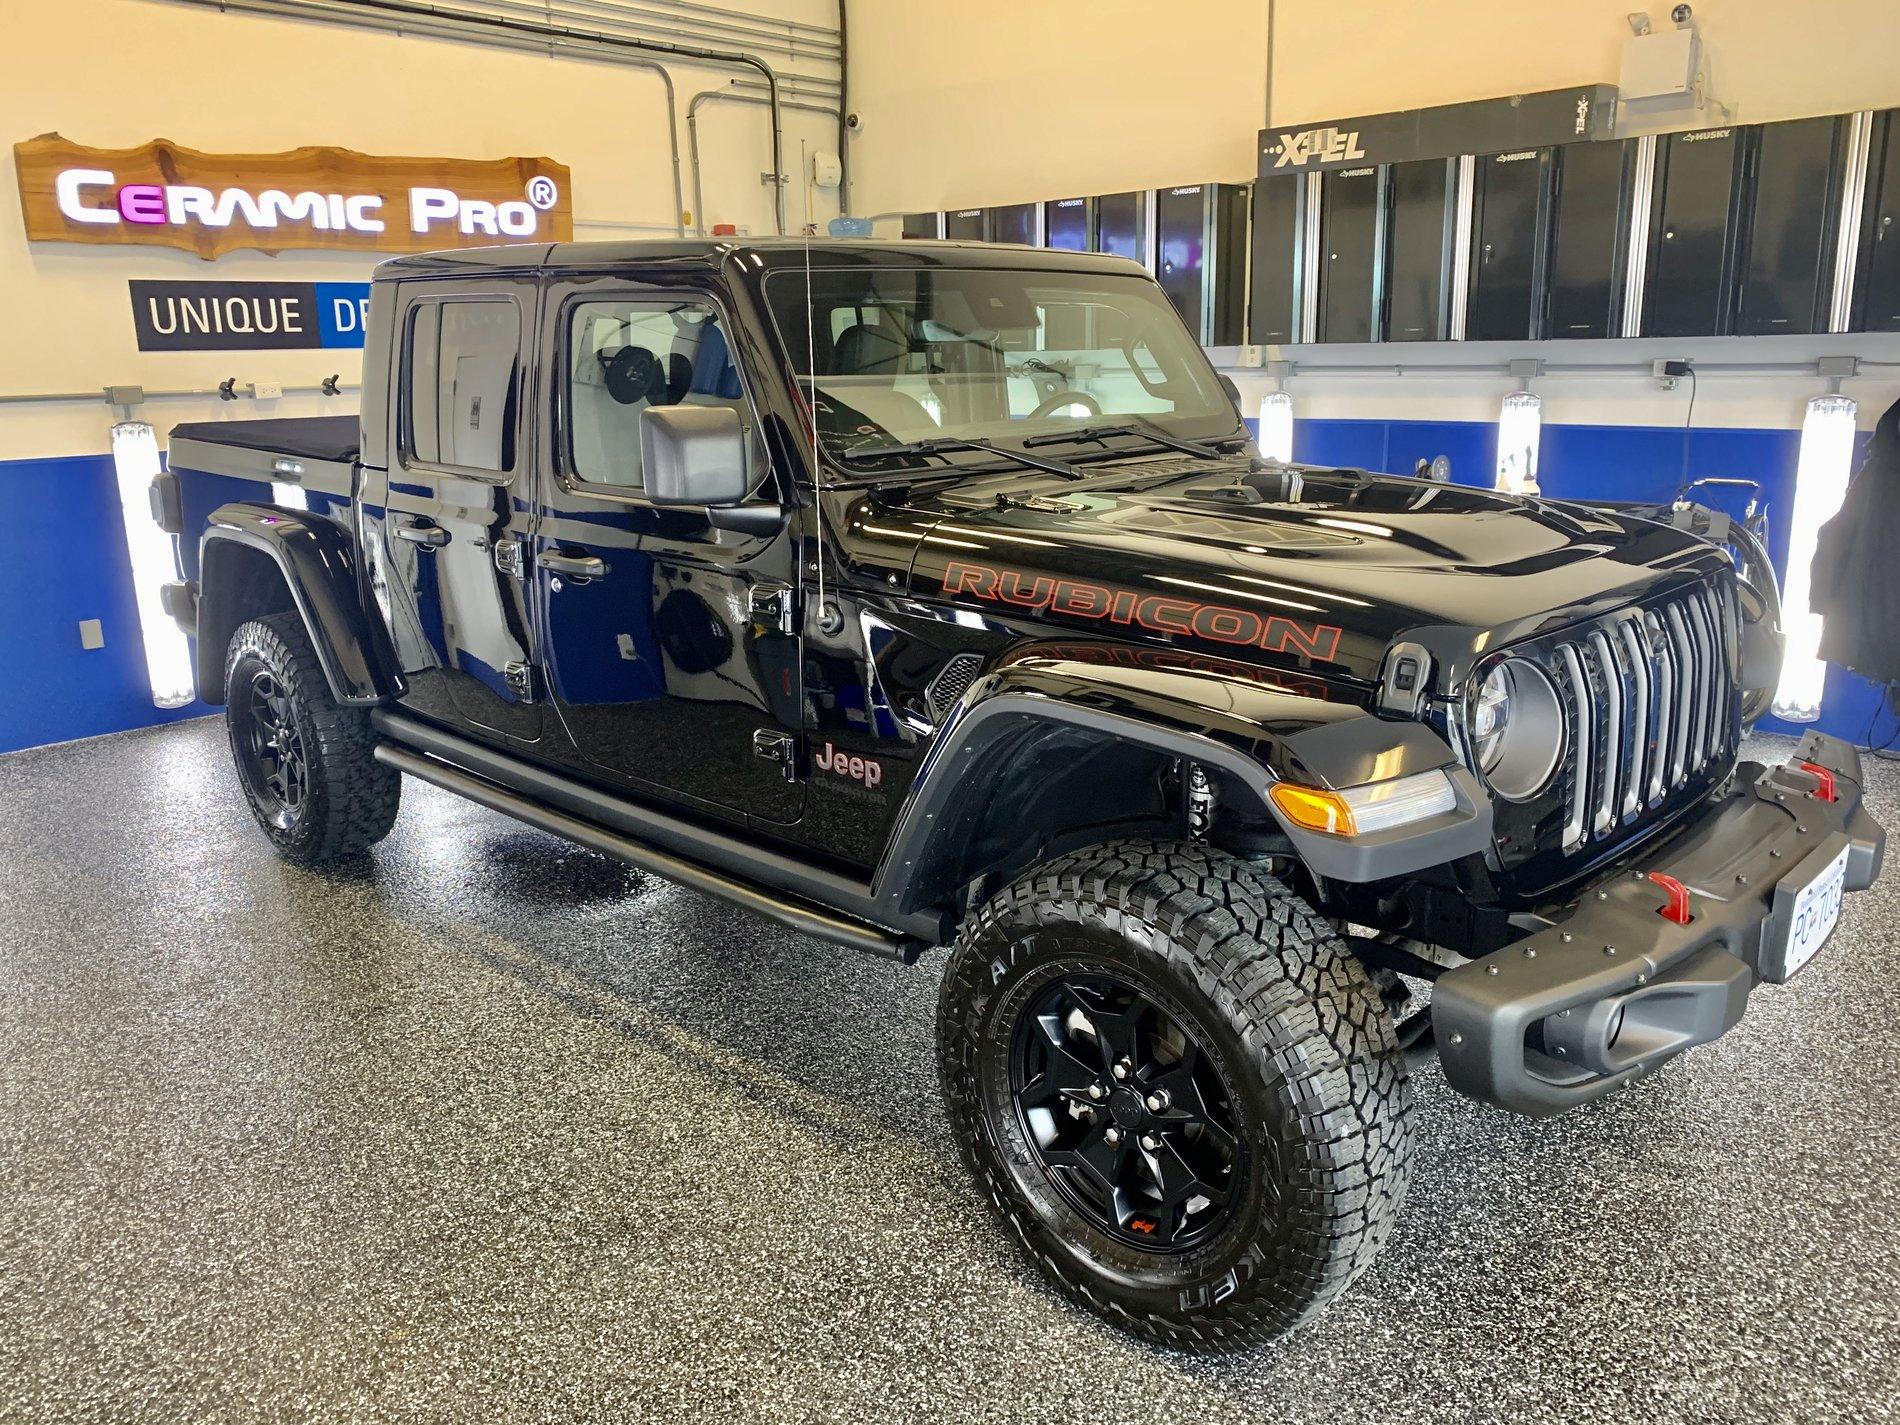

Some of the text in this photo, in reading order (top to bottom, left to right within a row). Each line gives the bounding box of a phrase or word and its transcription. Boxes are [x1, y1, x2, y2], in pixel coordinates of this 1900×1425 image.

[149, 296, 303, 334] UNIQUE
[942, 560, 1343, 663] RUBICON
[815, 742, 882, 789] Jeep
